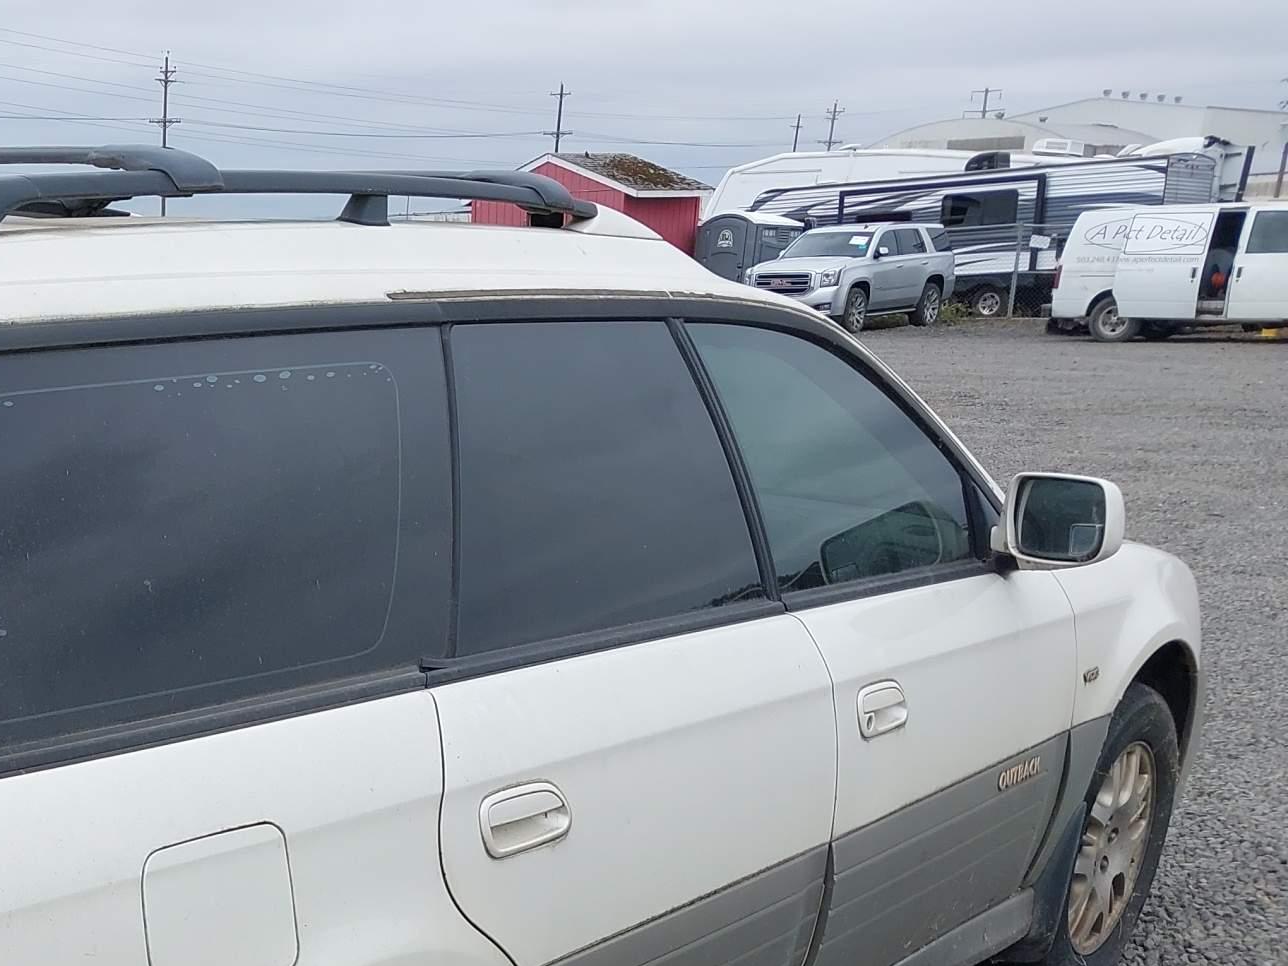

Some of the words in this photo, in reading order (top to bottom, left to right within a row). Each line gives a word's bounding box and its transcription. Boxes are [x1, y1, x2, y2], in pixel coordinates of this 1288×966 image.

[1091, 225, 1107, 240] A
[1147, 222, 1205, 241] Detail
[998, 756, 1041, 792] OUTBACK
